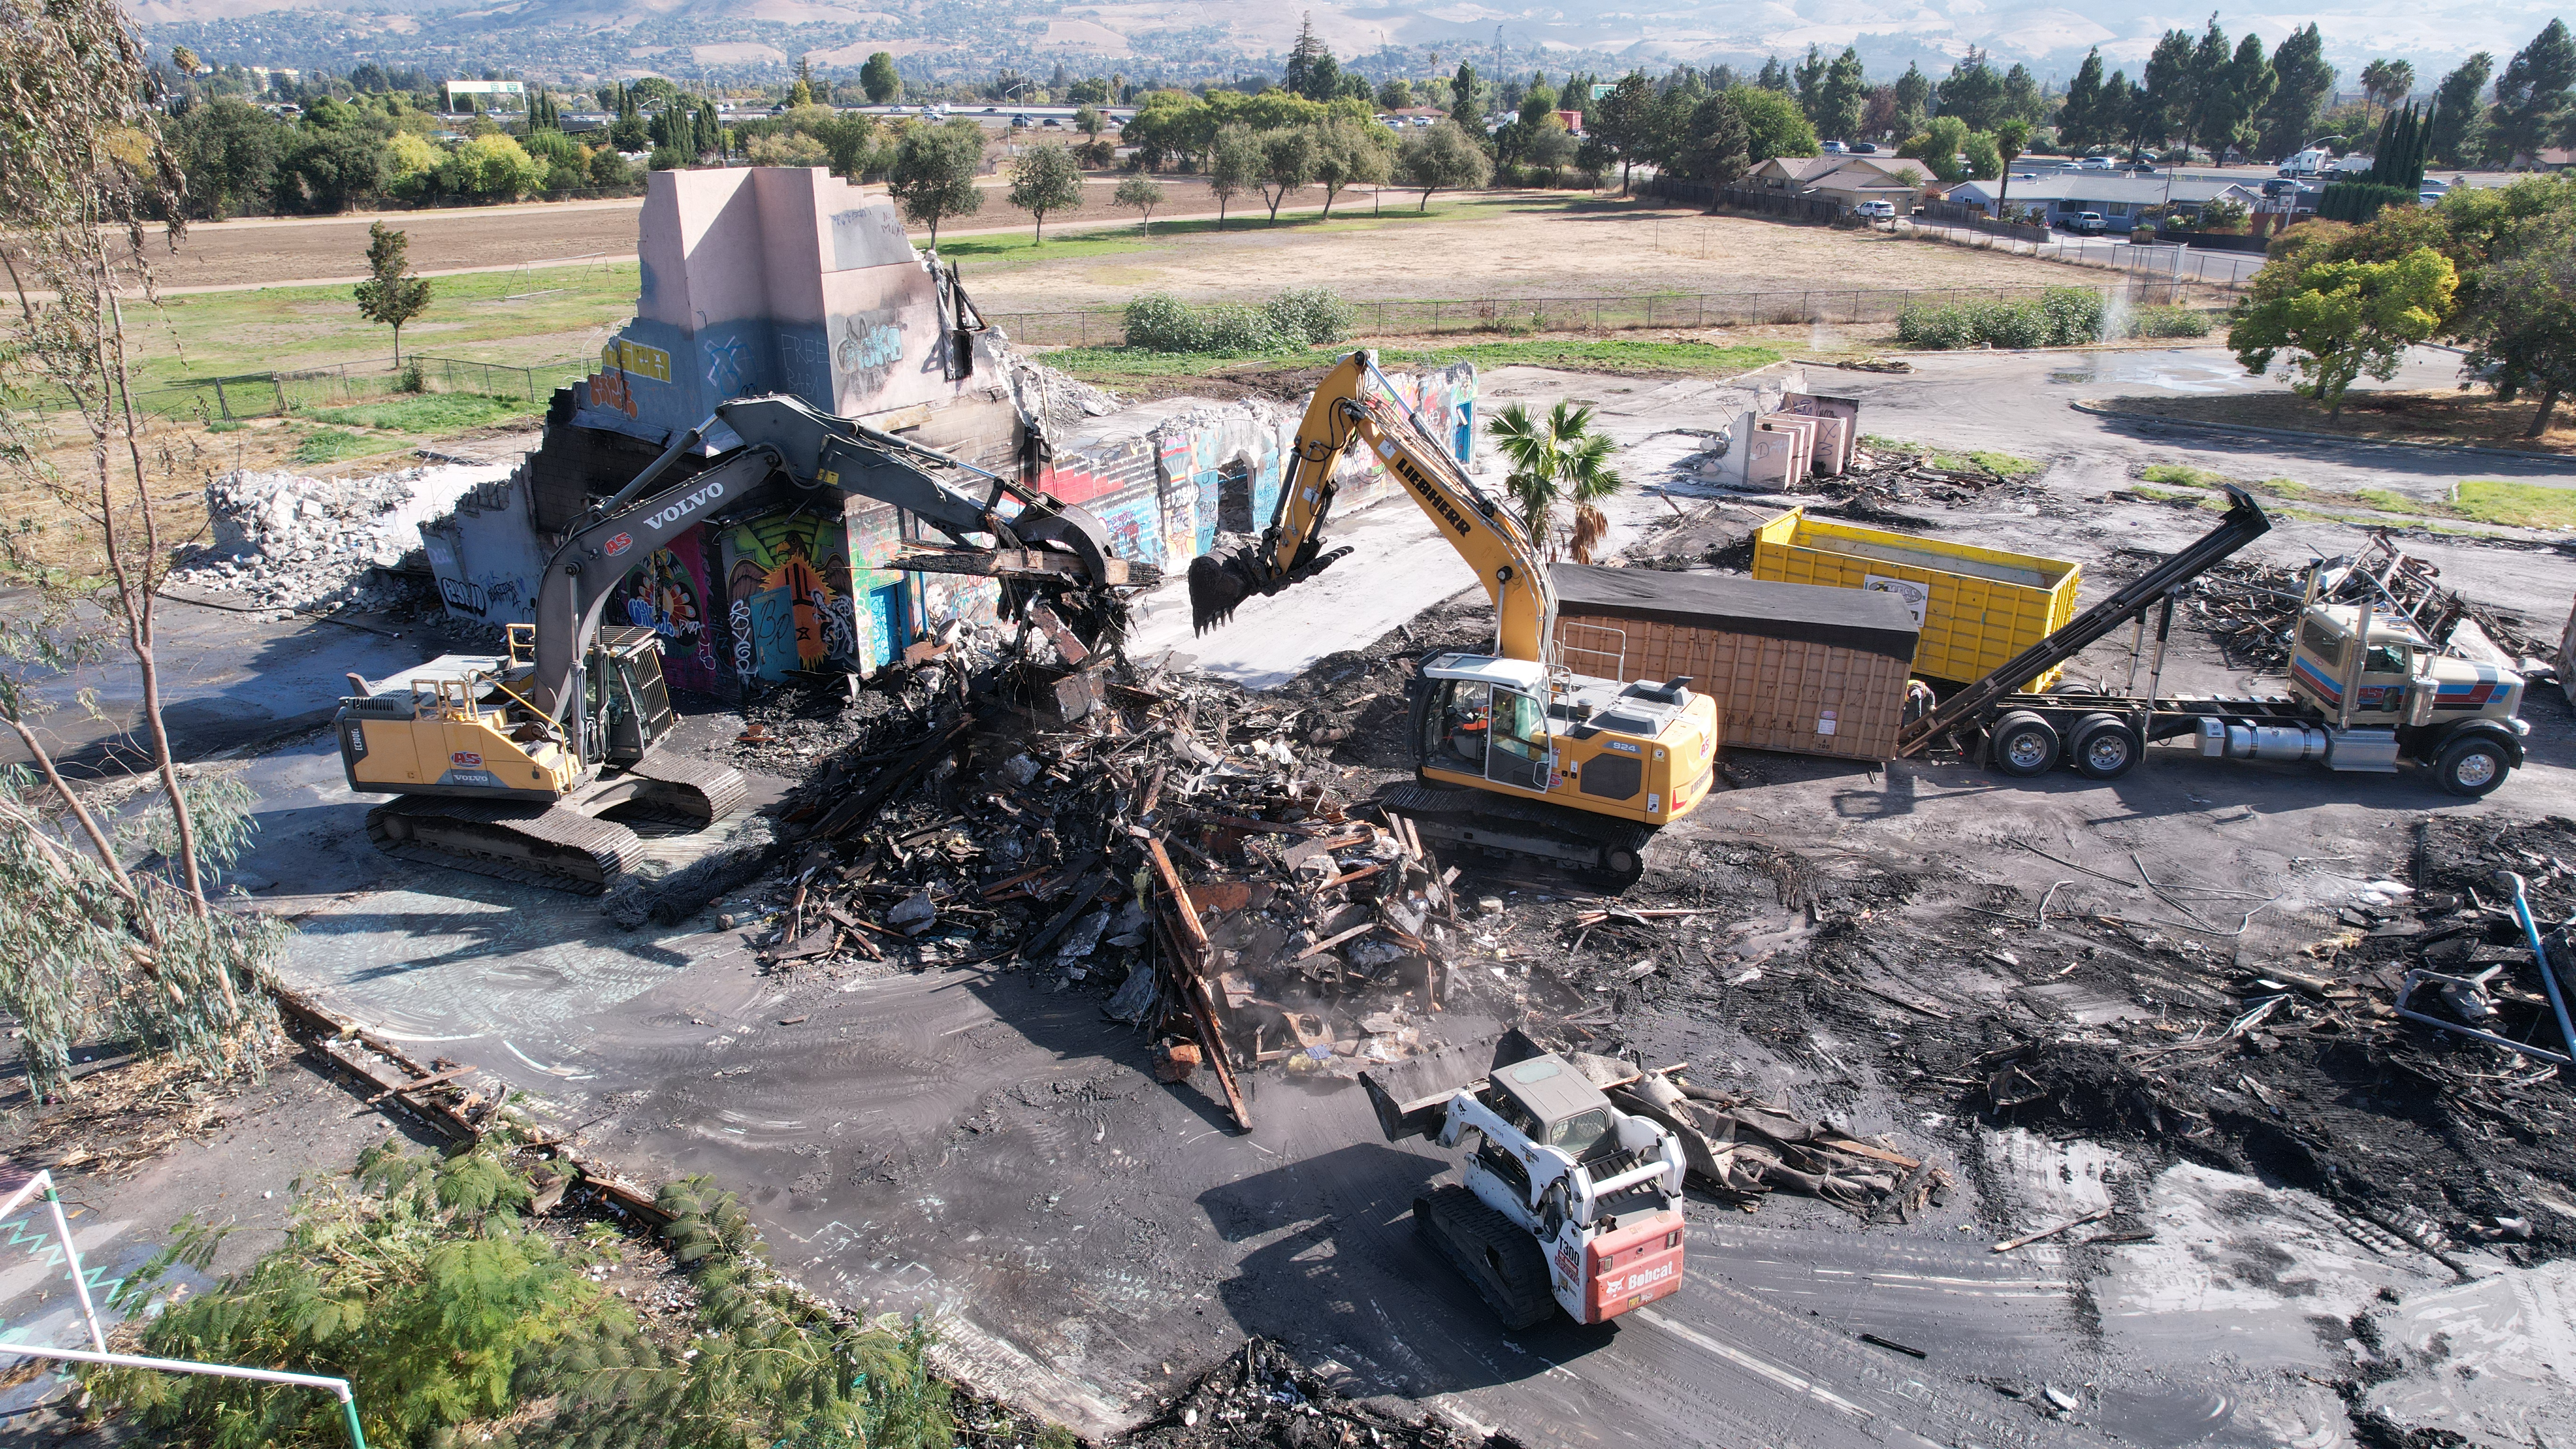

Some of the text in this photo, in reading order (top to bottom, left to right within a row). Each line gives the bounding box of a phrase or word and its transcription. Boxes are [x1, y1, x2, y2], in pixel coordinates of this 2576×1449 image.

[781, 334, 830, 368] FREE
[643, 483, 724, 530] VOLVO
[1395, 457, 1471, 538] LIEBHERR
[605, 532, 631, 555] AS
[454, 753, 480, 765] AS
[1613, 742, 1636, 752] 924
[1559, 1234, 1580, 1267] T300
[1628, 1261, 1673, 1290] Bobcat
